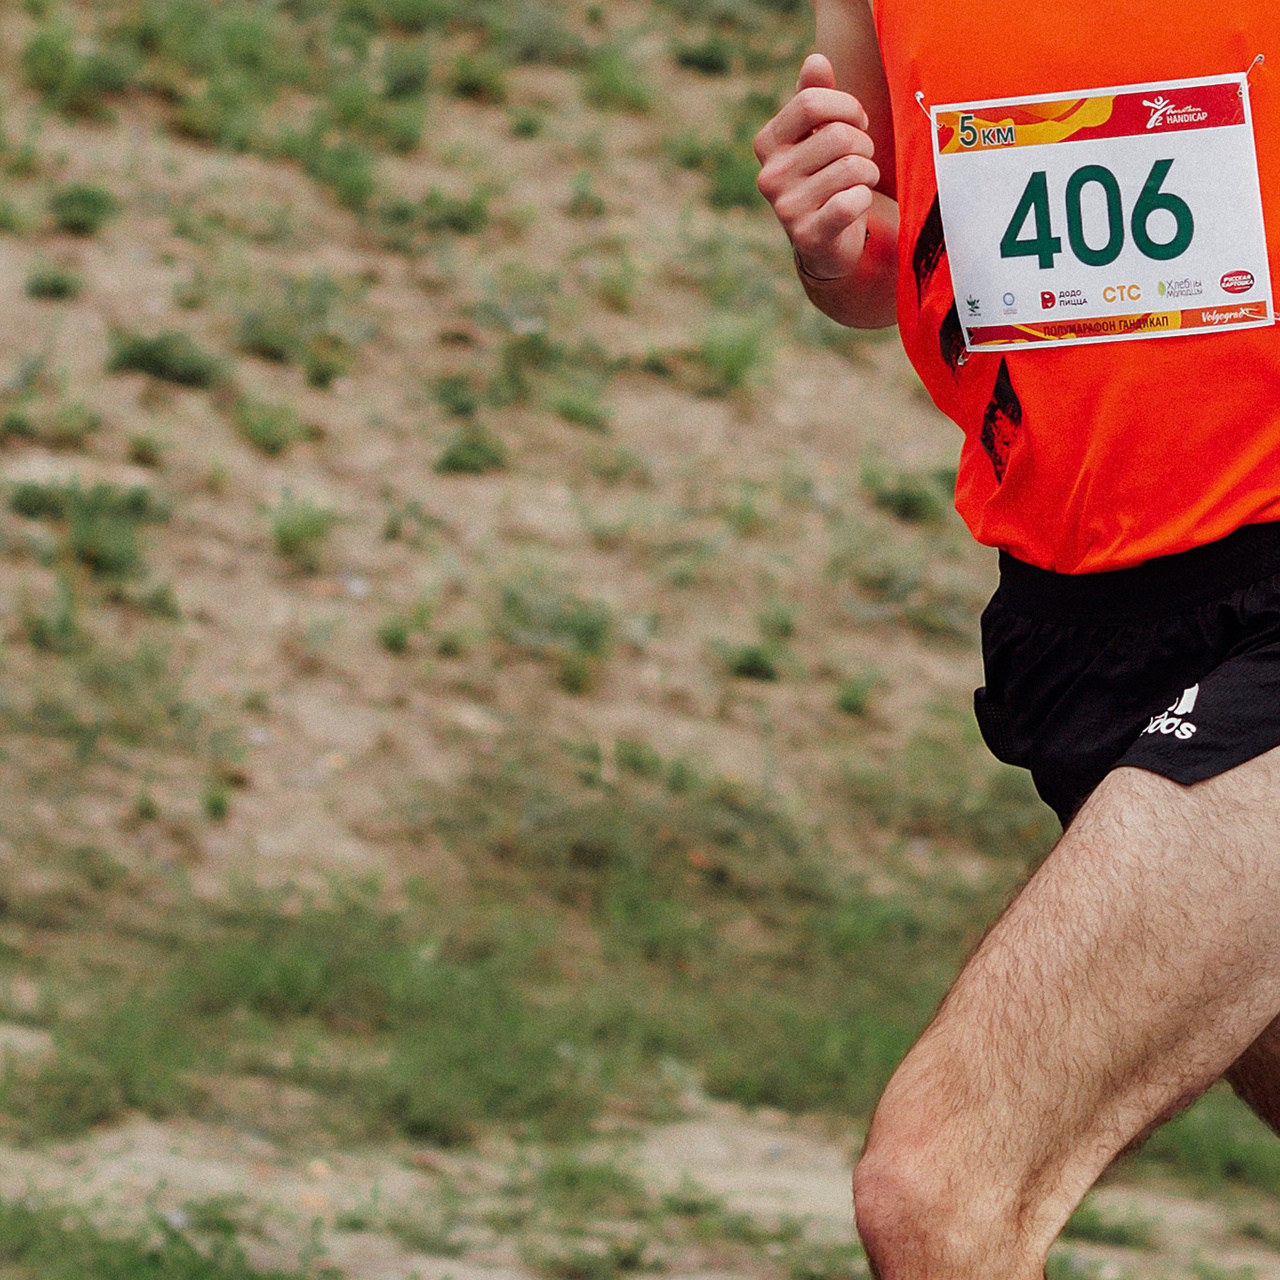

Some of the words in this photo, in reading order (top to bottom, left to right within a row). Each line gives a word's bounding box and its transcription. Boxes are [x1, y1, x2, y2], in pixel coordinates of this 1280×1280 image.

[1166, 112, 1208, 124] HANDICAP
[959, 114, 979, 147] 5
[1000, 158, 1194, 270] 406
[1059, 289, 1082, 299] ДОДО
[1059, 298, 1088, 307] ПИЦЦА
[1043, 320, 1116, 337] ПОЛУМАРАФОН
[1118, 316, 1169, 331] ГАНДИКАП
